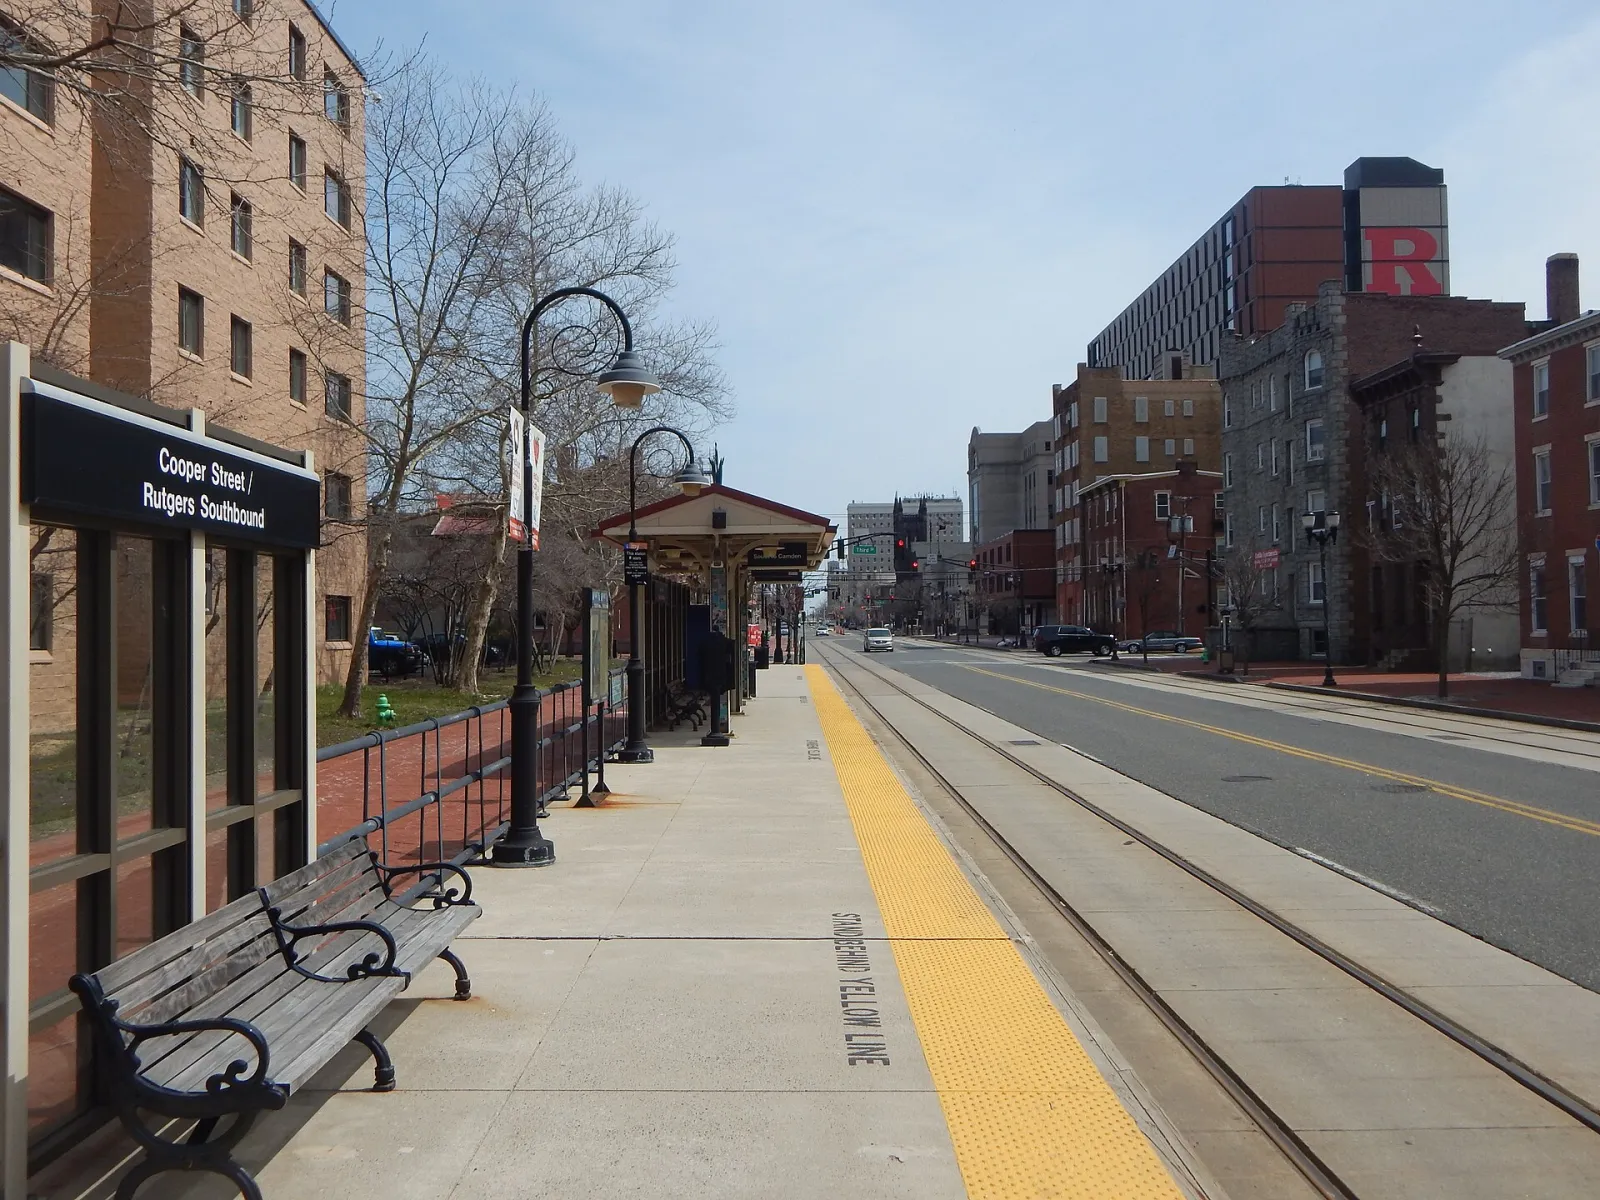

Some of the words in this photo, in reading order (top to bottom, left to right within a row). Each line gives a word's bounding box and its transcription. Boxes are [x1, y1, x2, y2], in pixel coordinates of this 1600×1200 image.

[1365, 227, 1443, 296] R
[159, 447, 207, 483] Cooper
[212, 462, 246, 492] Street
[248, 471, 254, 495] /
[143, 482, 195, 517] Rutgers
[200, 494, 265, 529] Southbound
[832, 912, 864, 937] STAND
[834, 938, 871, 973] BEHIND
[839, 977, 882, 1028] YELLOW
[845, 1033, 891, 1066] LINE
